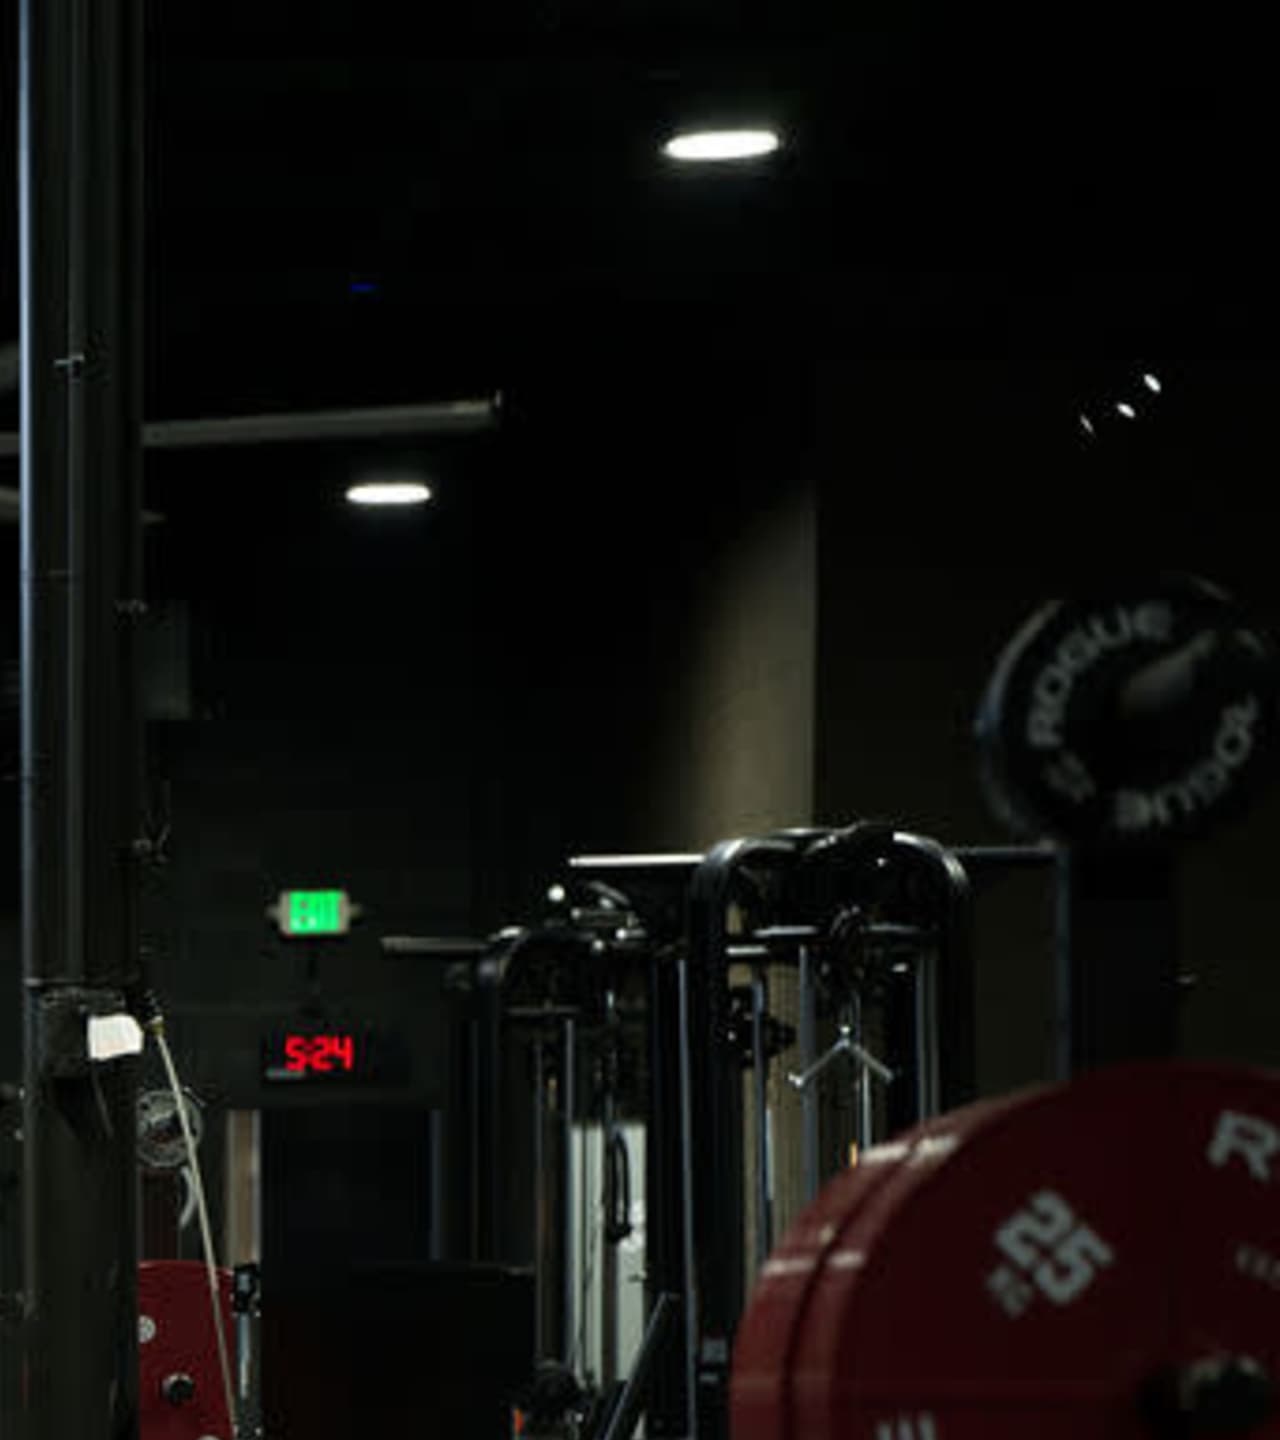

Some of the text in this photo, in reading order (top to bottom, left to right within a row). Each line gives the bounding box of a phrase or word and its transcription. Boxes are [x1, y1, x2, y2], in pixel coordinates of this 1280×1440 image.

[1027, 600, 1175, 750] ROGUE
[284, 1034, 354, 1072] 5:24
[994, 1189, 1116, 1306] 25
